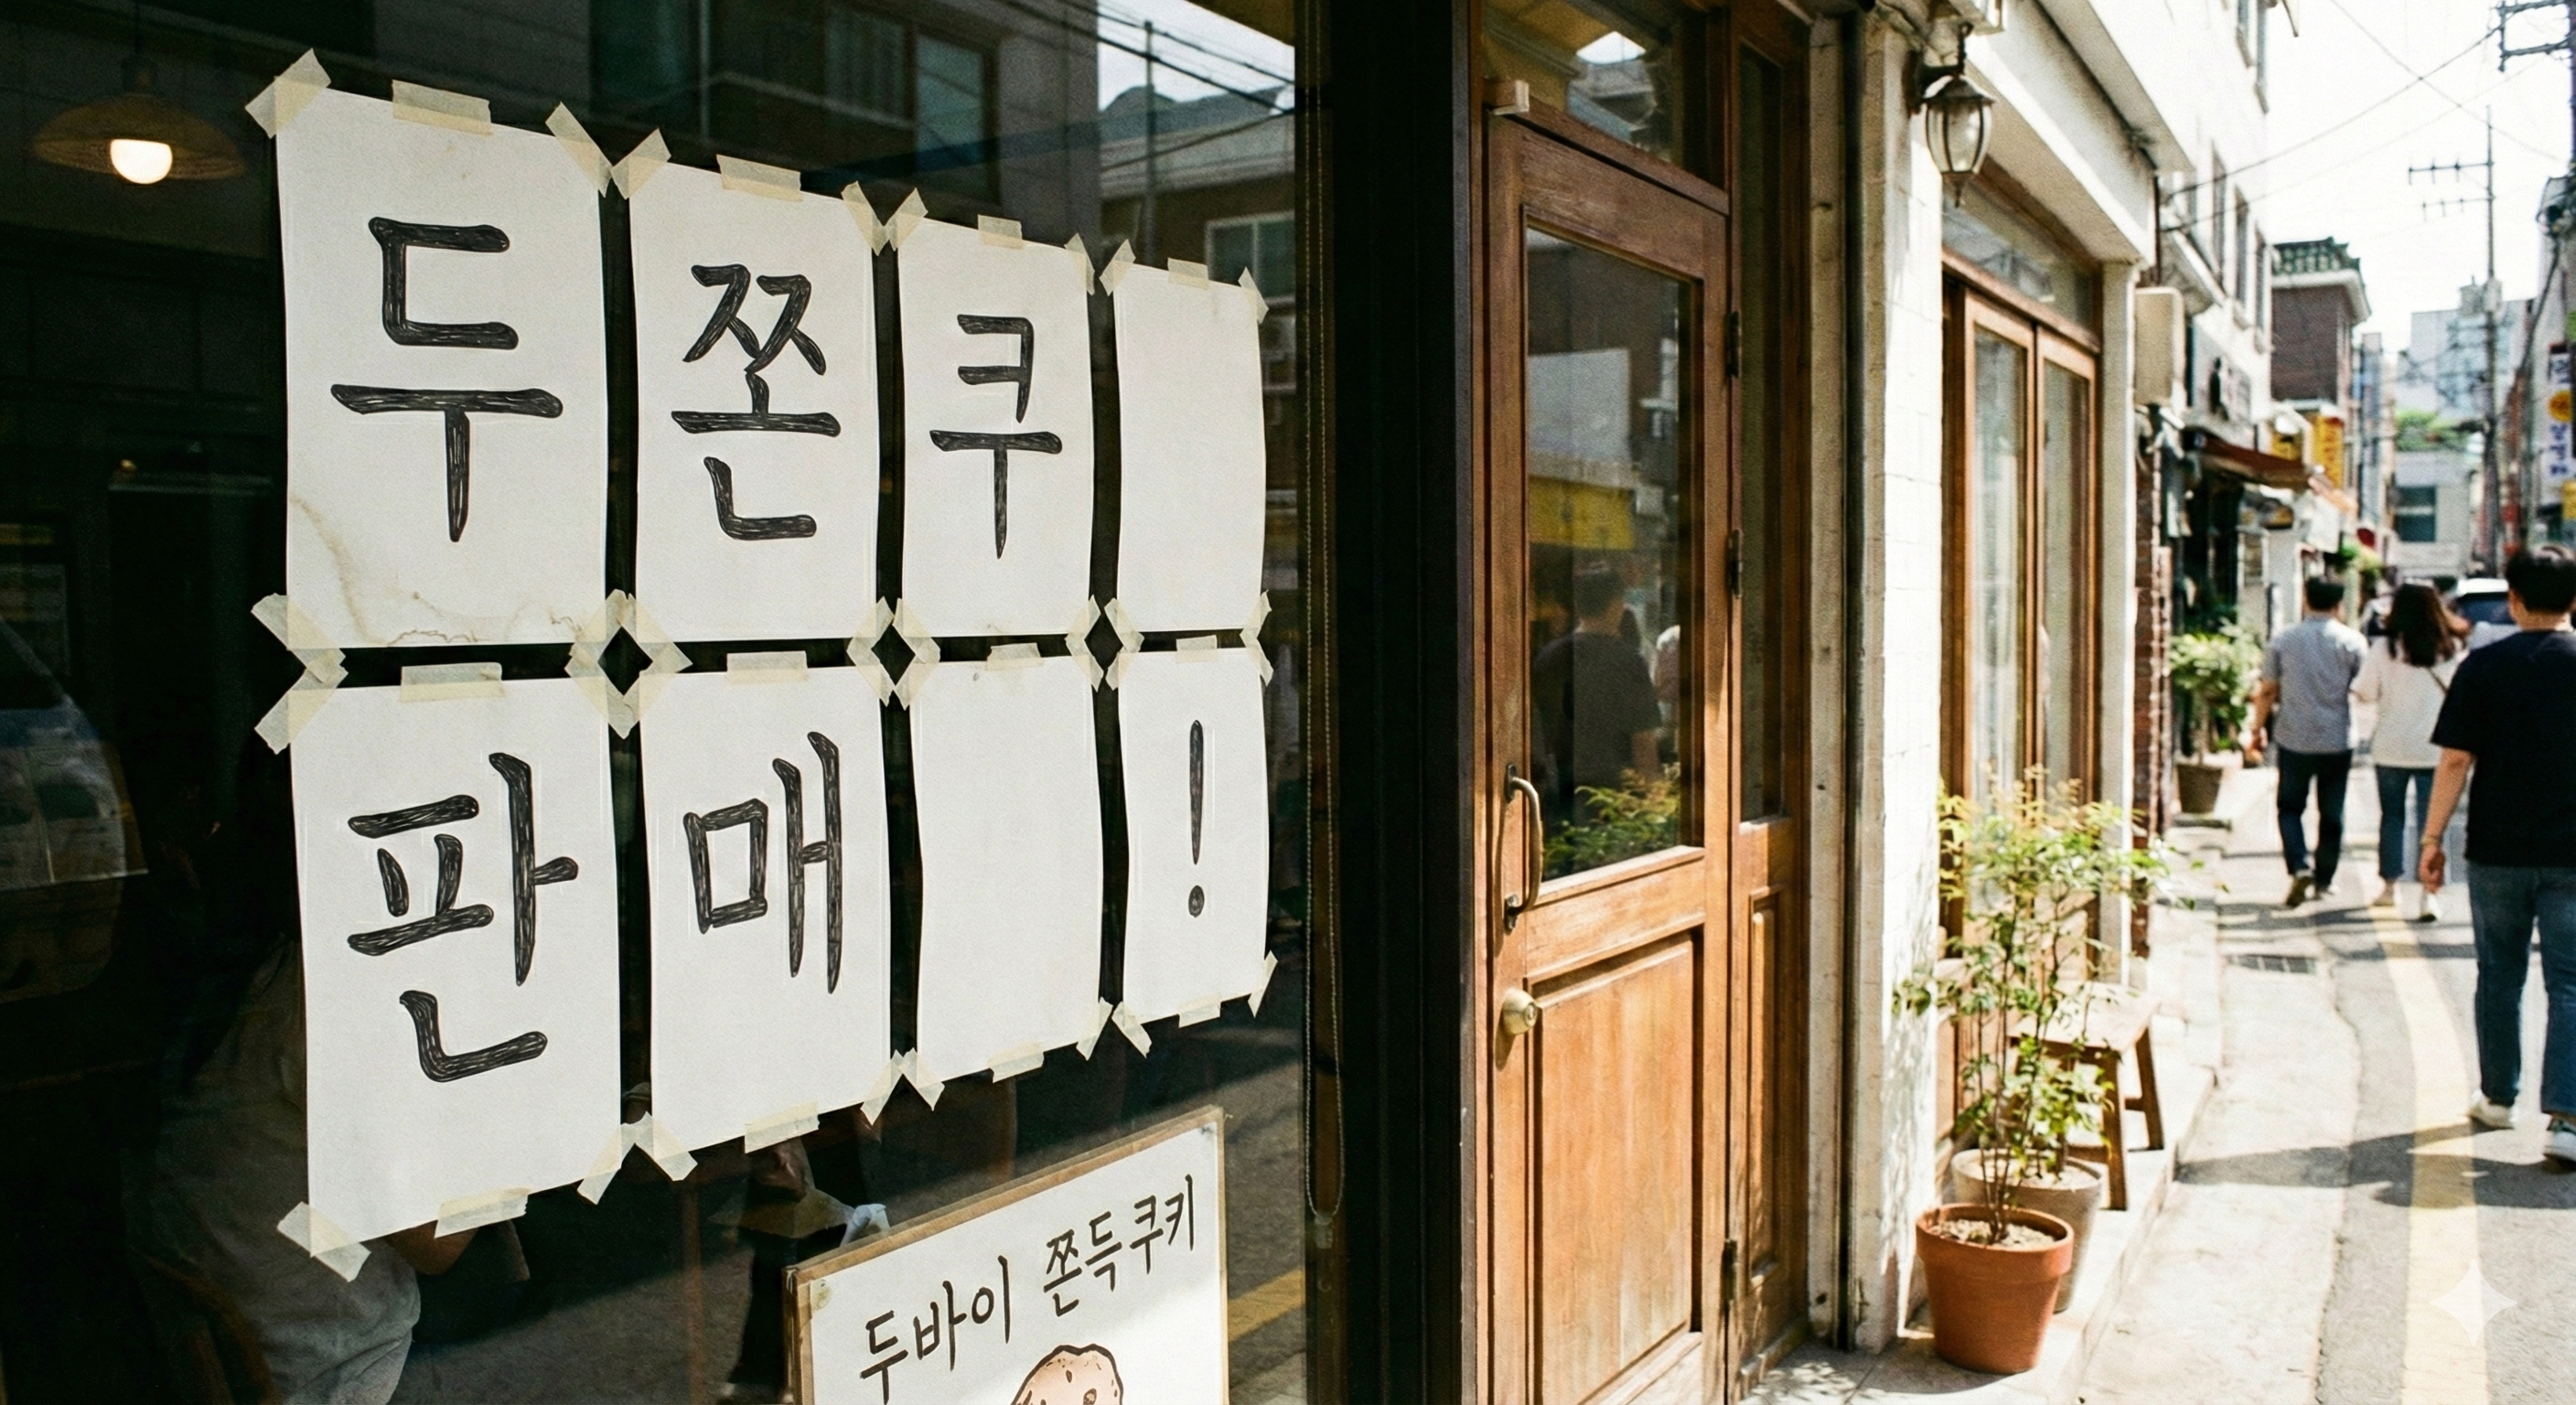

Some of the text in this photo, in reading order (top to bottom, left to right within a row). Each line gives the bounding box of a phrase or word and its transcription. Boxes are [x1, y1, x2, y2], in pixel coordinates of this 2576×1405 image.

[330, 216, 1064, 561] 두쫀쿠
[346, 730, 844, 1084] 판매
[859, 1173, 1195, 1405] 두바이 쫀득쿠키
